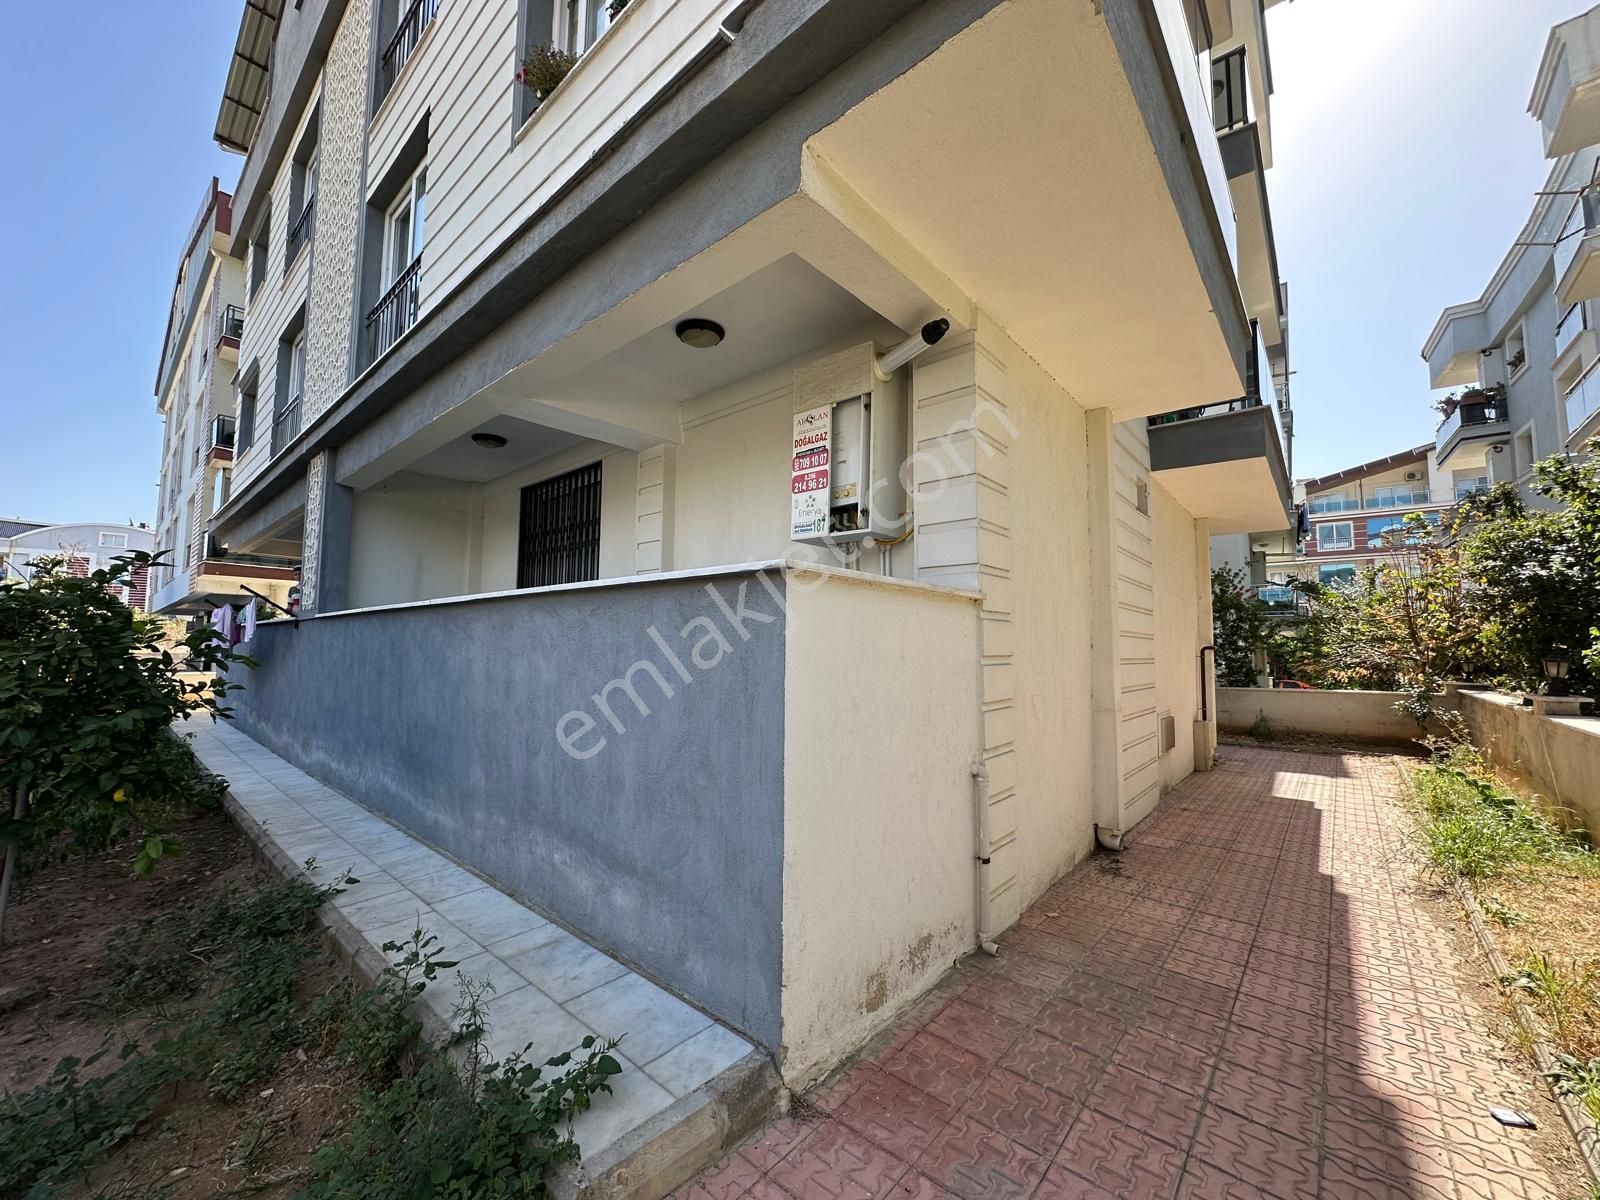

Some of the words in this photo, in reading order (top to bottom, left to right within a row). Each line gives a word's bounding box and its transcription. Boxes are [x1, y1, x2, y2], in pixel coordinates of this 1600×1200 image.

[794, 432, 828, 448] DOĞALGAZ
[799, 457, 810, 469] 709
[812, 455, 819, 466] 10
[820, 453, 828, 464] 07
[794, 482, 807, 493] 214
[808, 479, 817, 490] 96
[818, 477, 827, 488] 21
[799, 508, 822, 518] Enerya
[813, 518, 826, 533] 187
